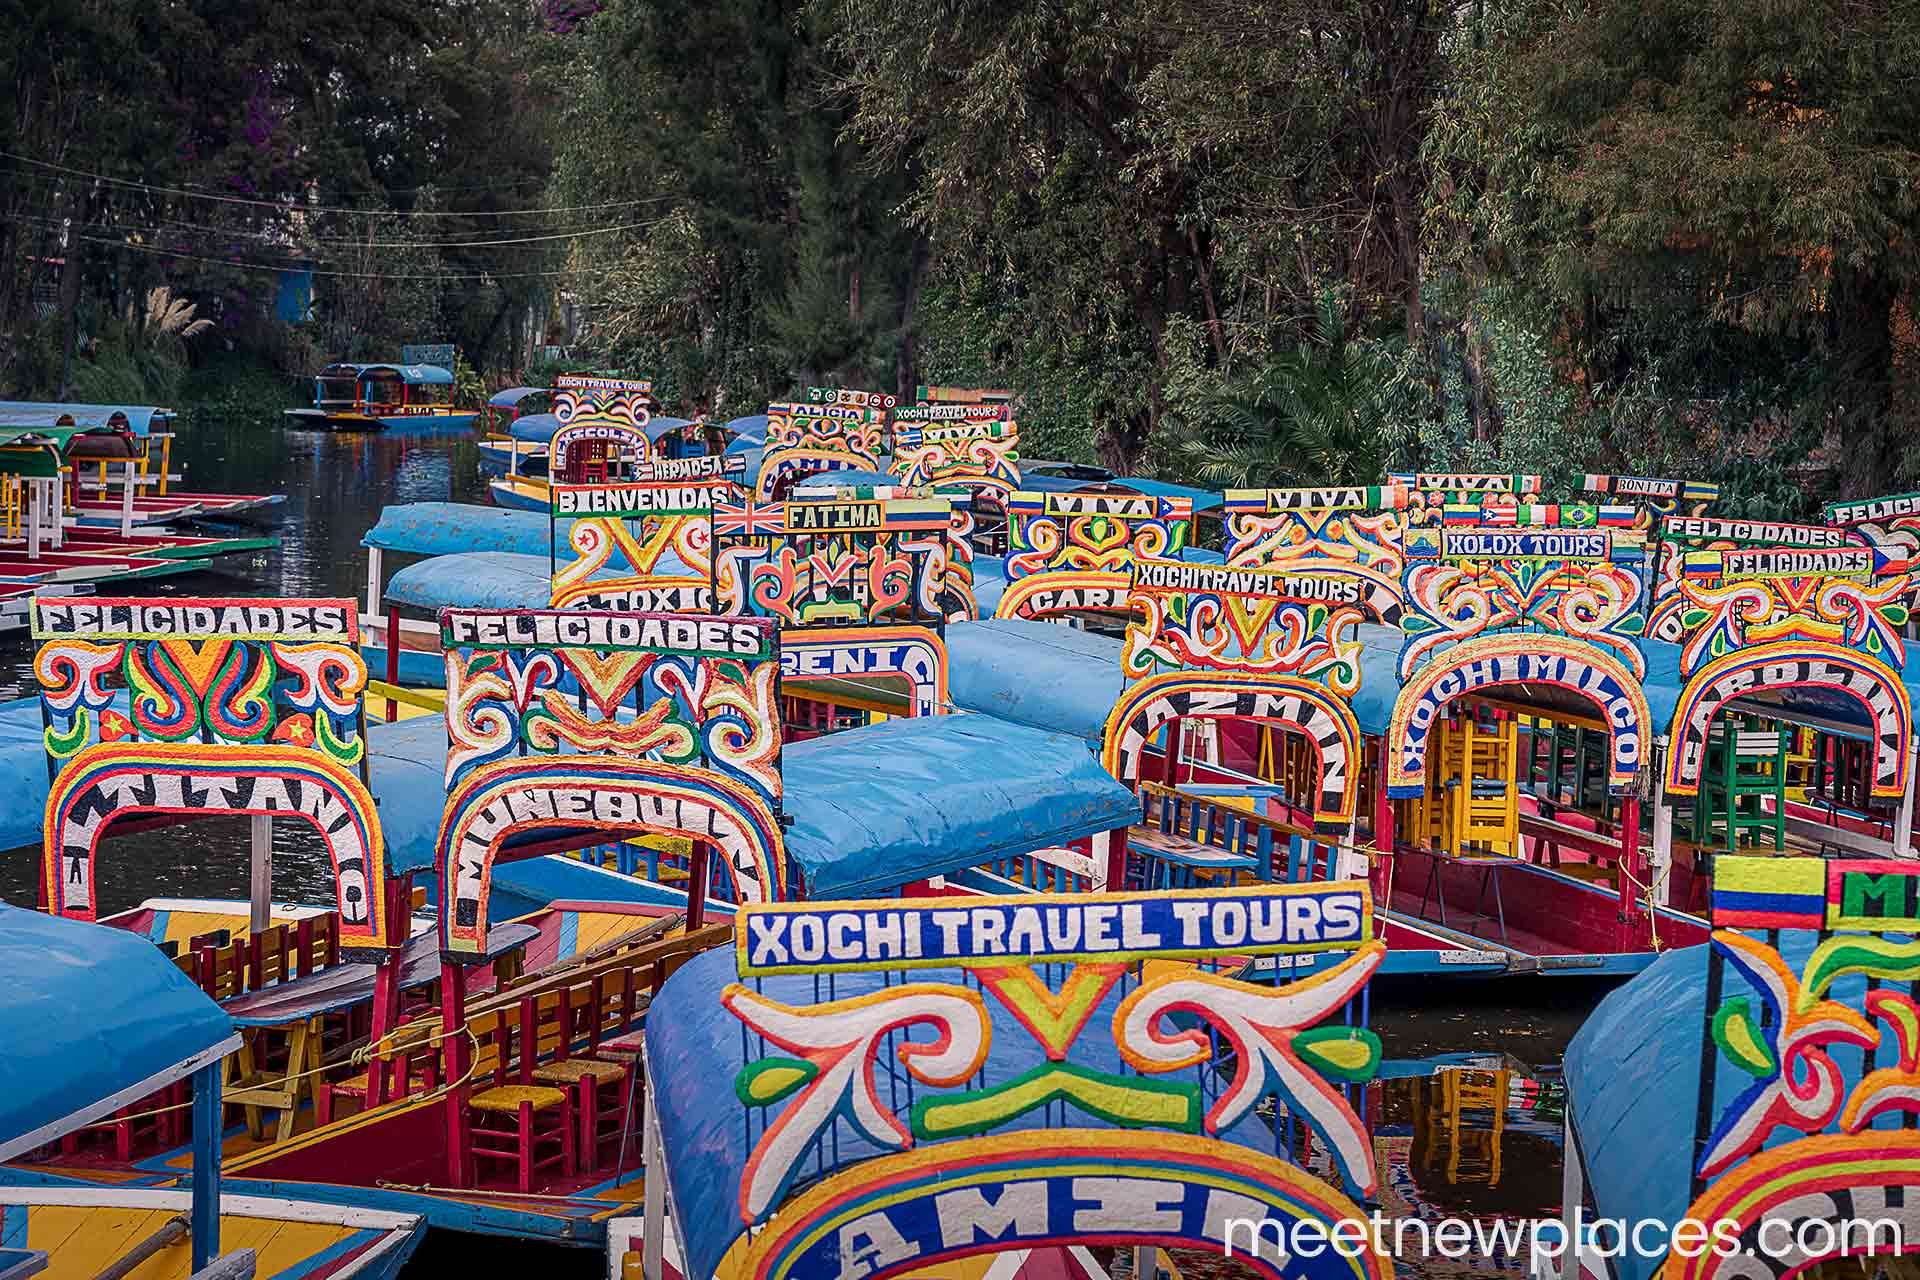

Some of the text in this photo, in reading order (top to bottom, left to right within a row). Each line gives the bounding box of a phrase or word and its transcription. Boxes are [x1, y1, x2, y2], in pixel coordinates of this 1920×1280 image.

[794, 405, 860, 419] ALICIA
[925, 426, 989, 441] VIVA
[655, 457, 723, 480] HERMOSA
[1425, 477, 1506, 489] VIVA
[1619, 479, 1674, 494] BONITA
[559, 487, 728, 512] BIENVENIDAS
[1055, 496, 1151, 515] VIVA
[1272, 491, 1363, 508] VIVA
[789, 504, 880, 528] FATIMA
[1667, 519, 1841, 547] FELICIDADES
[1450, 535, 1605, 556] XOLOX TOURS
[1728, 551, 1868, 573] FELICIDADES
[1287, 578, 1360, 603] TOURS
[42, 605, 343, 635] FELICIDADES
[452, 613, 763, 654] FELICIDADES
[1403, 655, 1639, 772] XOCHIMILCO
[1682, 661, 1898, 780] CAROLINA
[749, 896, 1361, 965] XOCHI TRAVEL TOURS
